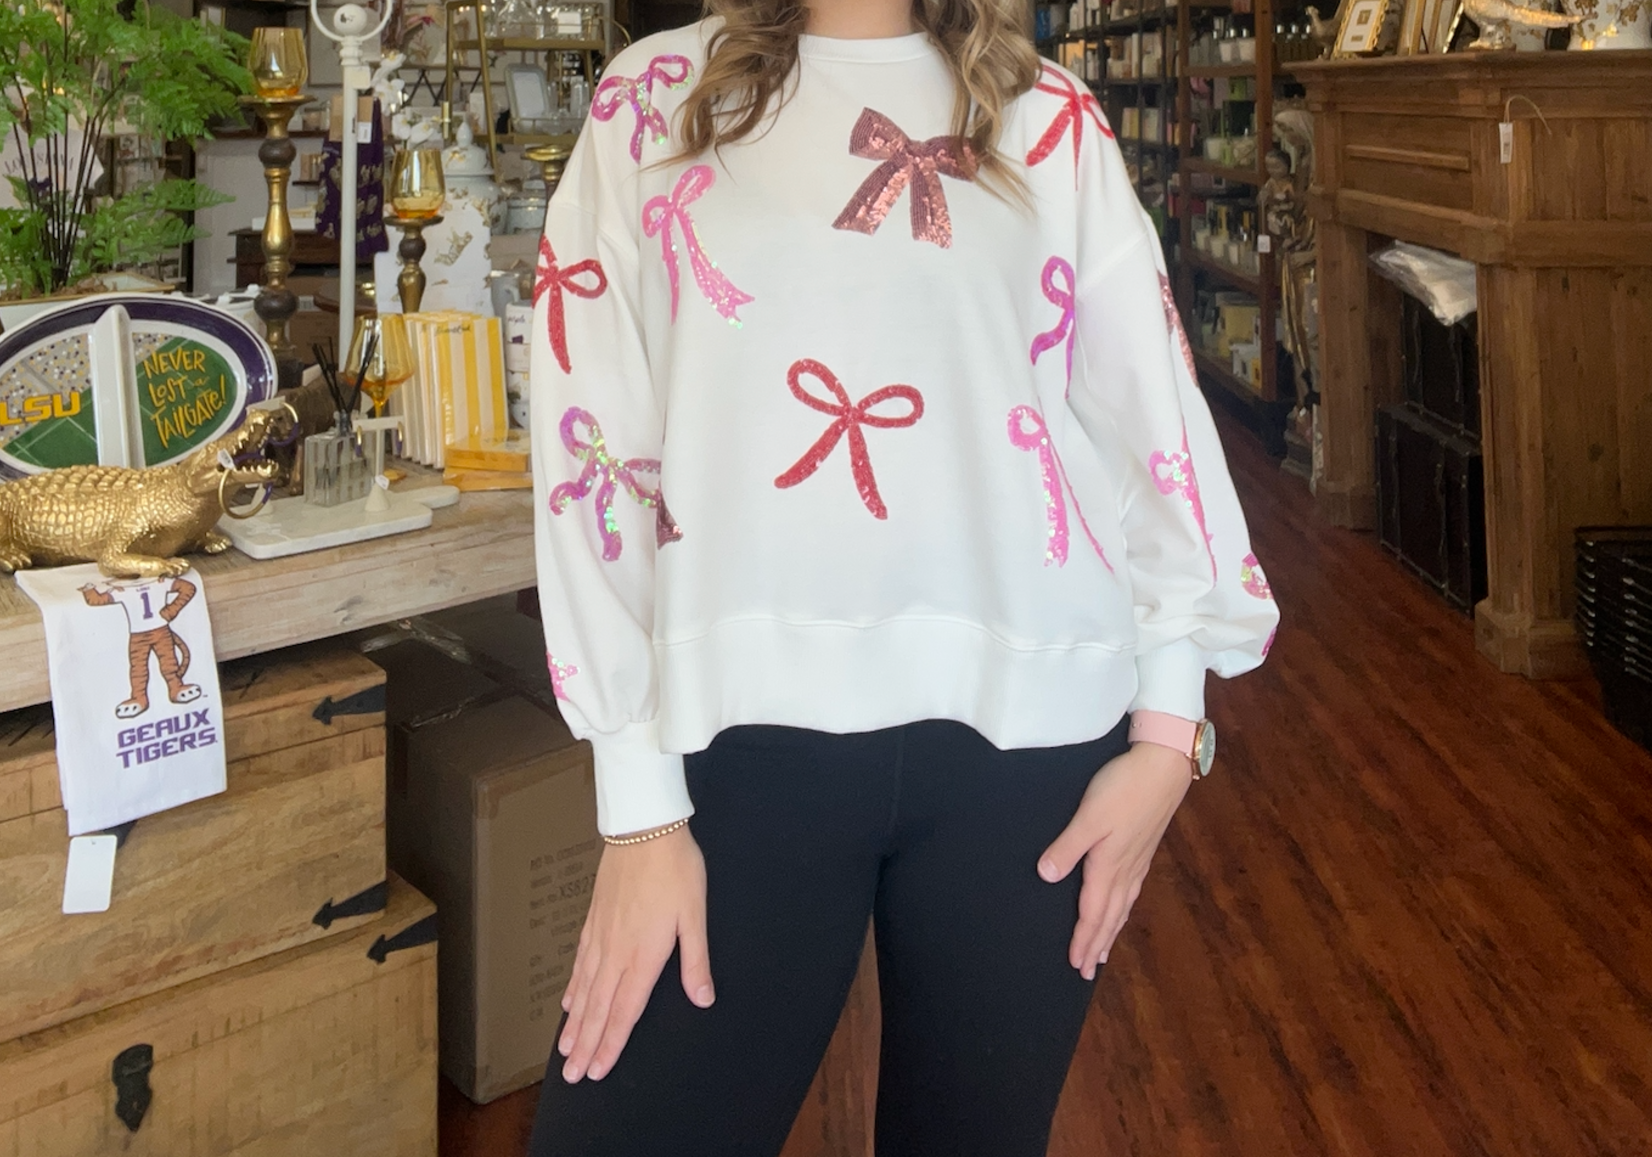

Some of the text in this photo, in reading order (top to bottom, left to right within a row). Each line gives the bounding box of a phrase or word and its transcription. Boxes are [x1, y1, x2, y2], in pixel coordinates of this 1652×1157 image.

[143, 346, 206, 379] NEVER
[0, 391, 81, 425] LSU
[140, 592, 153, 620] 1
[117, 707, 211, 749] GEAUX
[116, 727, 216, 769] TIGERS
